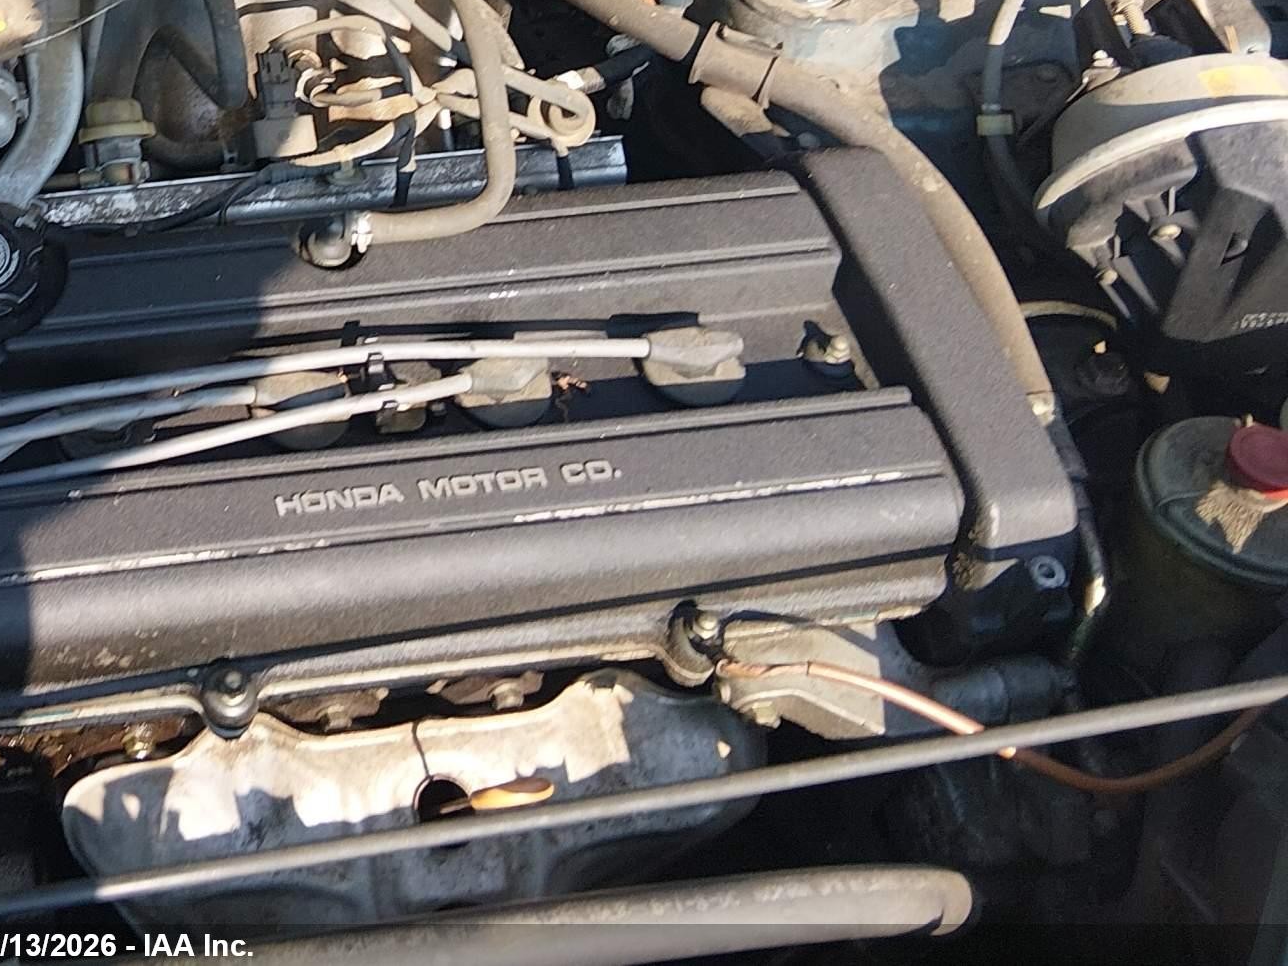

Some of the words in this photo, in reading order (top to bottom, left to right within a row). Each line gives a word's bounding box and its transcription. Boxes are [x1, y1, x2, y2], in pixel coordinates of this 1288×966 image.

[274, 483, 405, 517] HONDA
[417, 467, 549, 501] MOTOR
[560, 460, 623, 485] CO.
